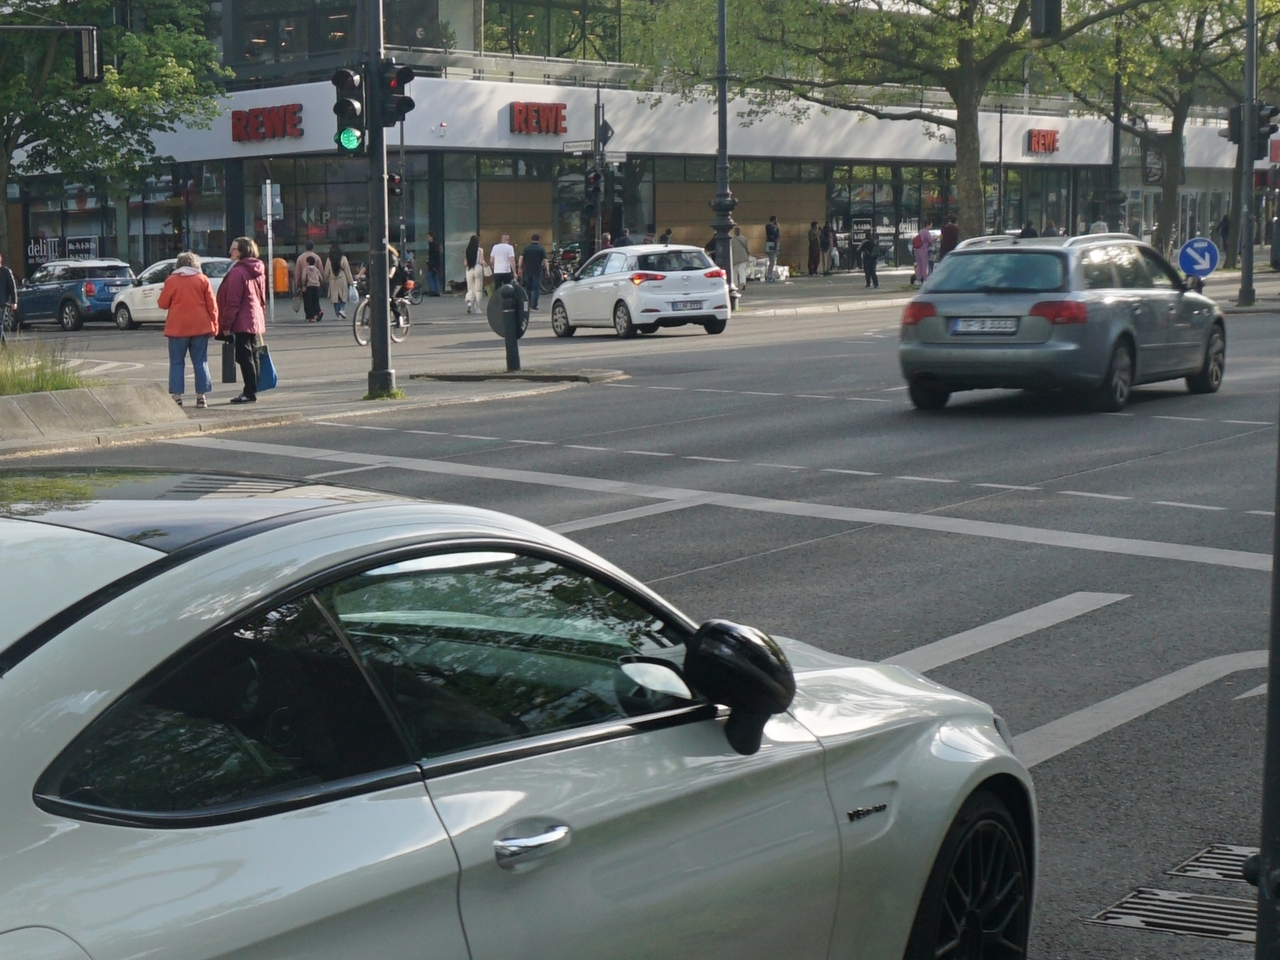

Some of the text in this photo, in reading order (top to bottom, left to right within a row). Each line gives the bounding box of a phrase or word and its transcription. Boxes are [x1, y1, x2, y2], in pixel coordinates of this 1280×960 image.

[231, 103, 304, 142] REWE
[510, 101, 568, 134] REWE
[1029, 129, 1060, 152] REWE
[27, 239, 47, 256] deli
